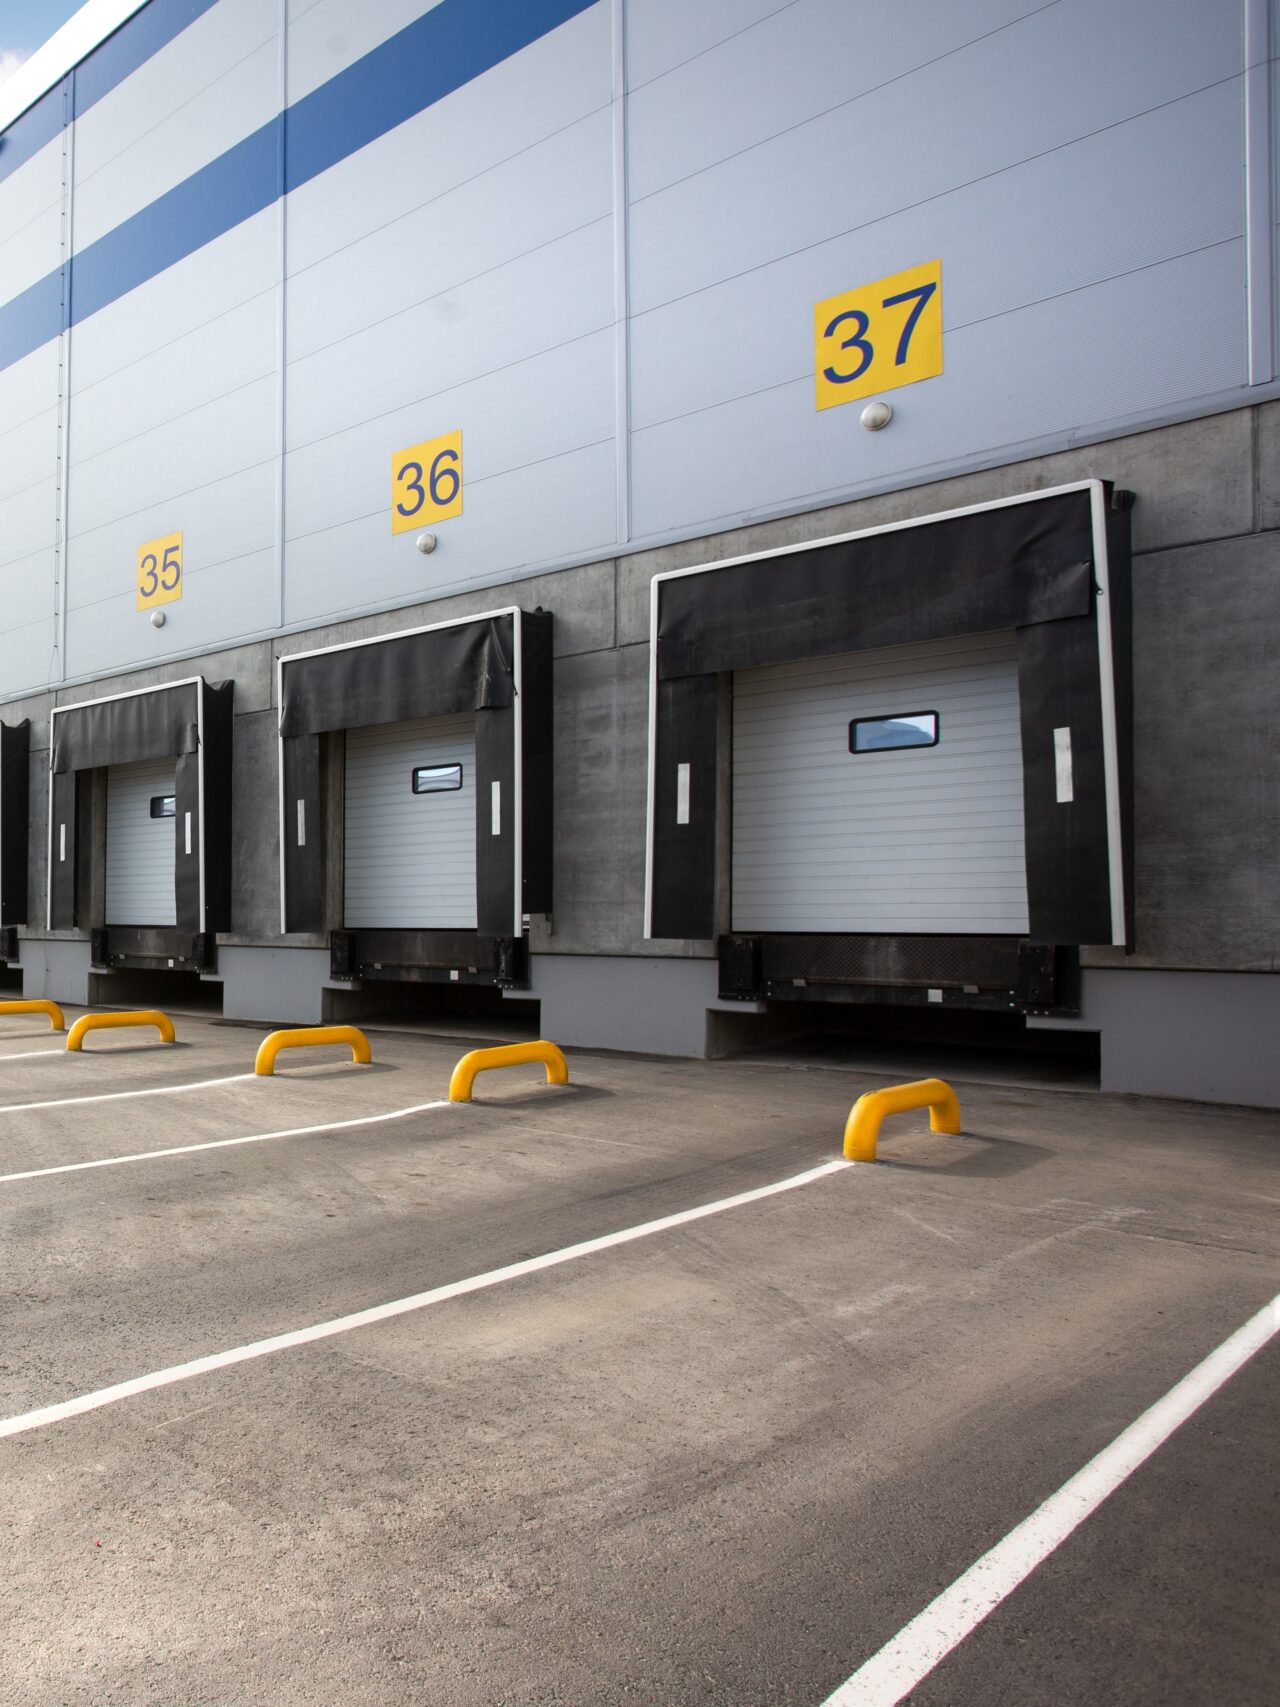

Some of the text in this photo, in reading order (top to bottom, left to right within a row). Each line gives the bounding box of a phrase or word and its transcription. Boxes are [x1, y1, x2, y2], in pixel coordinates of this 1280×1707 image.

[823, 281, 937, 384] 37
[396, 449, 460, 517] 36
[139, 544, 181, 598] 35
